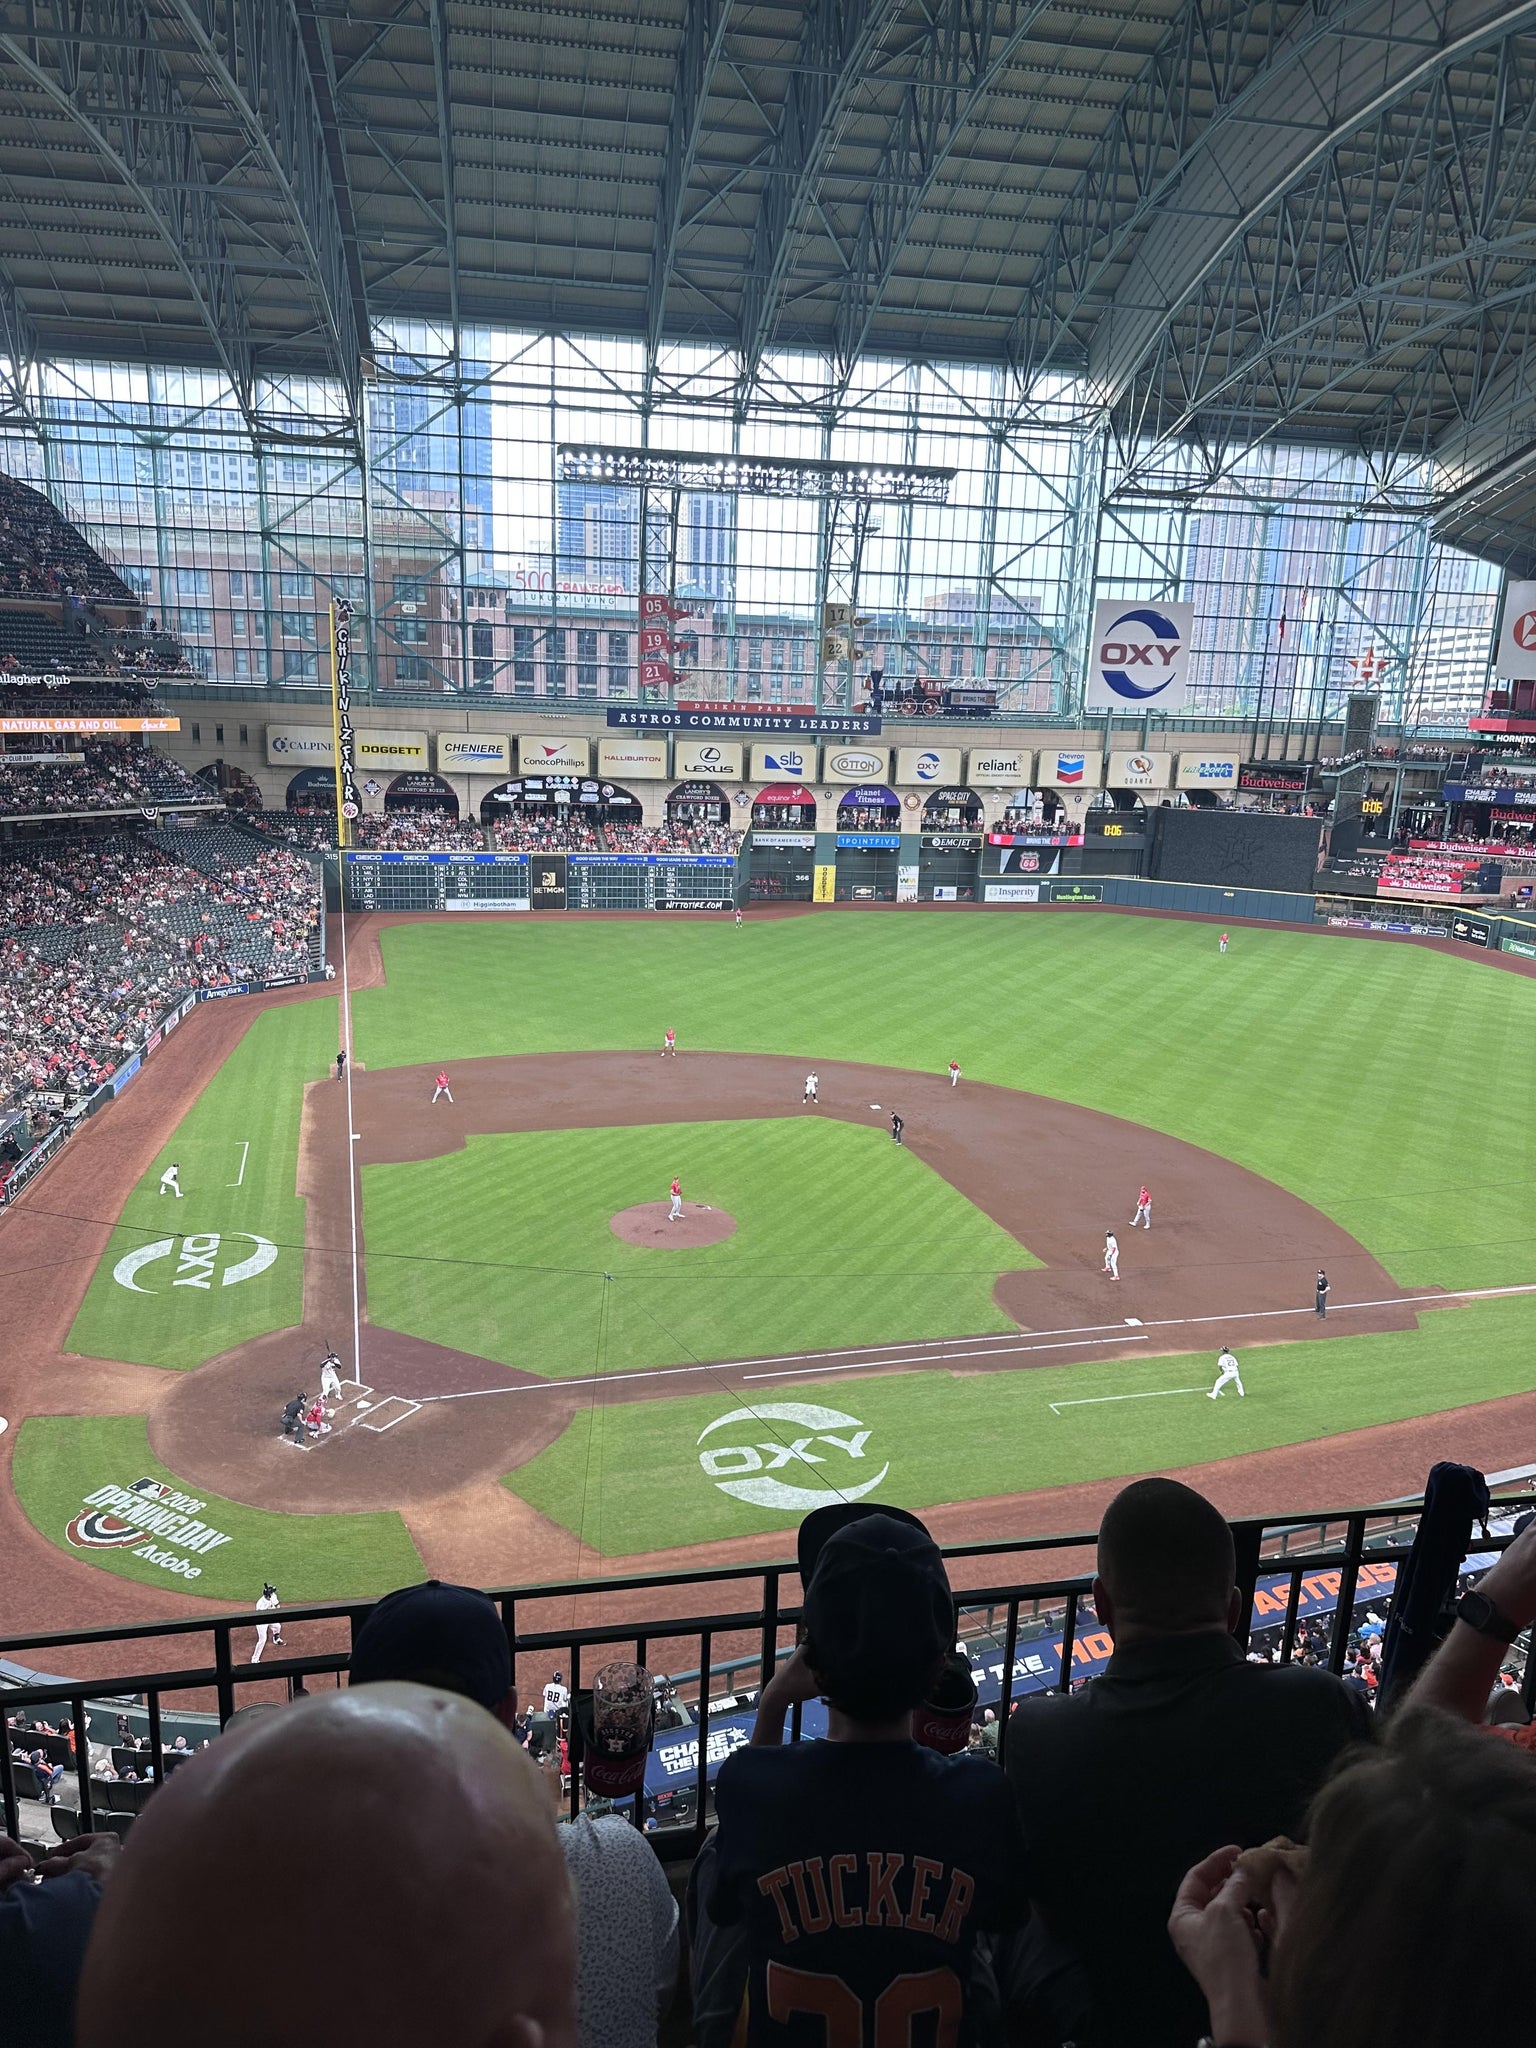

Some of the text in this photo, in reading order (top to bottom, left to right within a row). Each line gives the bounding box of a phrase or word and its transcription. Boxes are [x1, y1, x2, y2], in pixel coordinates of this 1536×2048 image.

[573, 596, 615, 604] LIVING
[646, 600, 662, 612] 05
[830, 608, 845, 621] 17
[647, 635, 662, 647] 19
[828, 643, 843, 655] 22
[1100, 643, 1181, 666] OXY
[646, 666, 660, 678] 21
[44, 674, 70, 685] Club
[694, 703, 792, 713] DAIKIN PARK
[2, 721, 52, 730] NATURAL
[55, 721, 76, 730] GAS
[79, 721, 99, 730] AND
[619, 713, 870, 731] ASTROS COMMUNITY LEADERS
[361, 745, 421, 756] DOGGETT
[445, 743, 503, 754] CHENIERE
[523, 757, 585, 768] ConocoPhillips
[780, 751, 803, 766] slb
[685, 765, 734, 773] LEXUS
[837, 758, 875, 773] COTTON
[977, 759, 1017, 771] reliant
[1199, 763, 1233, 778] LNG
[1239, 775, 1305, 790] Budweiser
[855, 789, 881, 799] planet
[858, 796, 885, 804] fitness
[1362, 801, 1383, 813] 0:06
[1104, 825, 1122, 836] 0:06
[1439, 842, 1488, 853] Budweiser
[324, 853, 338, 861] 315
[1023, 859, 1036, 867] 66
[998, 887, 1036, 897] Insperity
[1402, 881, 1451, 892] Budweiser
[665, 901, 723, 909] NITTOTIRE.COM
[173, 1233, 221, 1289] OXY
[699, 1430, 873, 1476] OXY
[160, 1491, 207, 1515] 2026
[82, 1484, 234, 1555] OPENING DAY
[132, 1544, 202, 1579] Adobe
[757, 1852, 975, 1944] TUCKER
